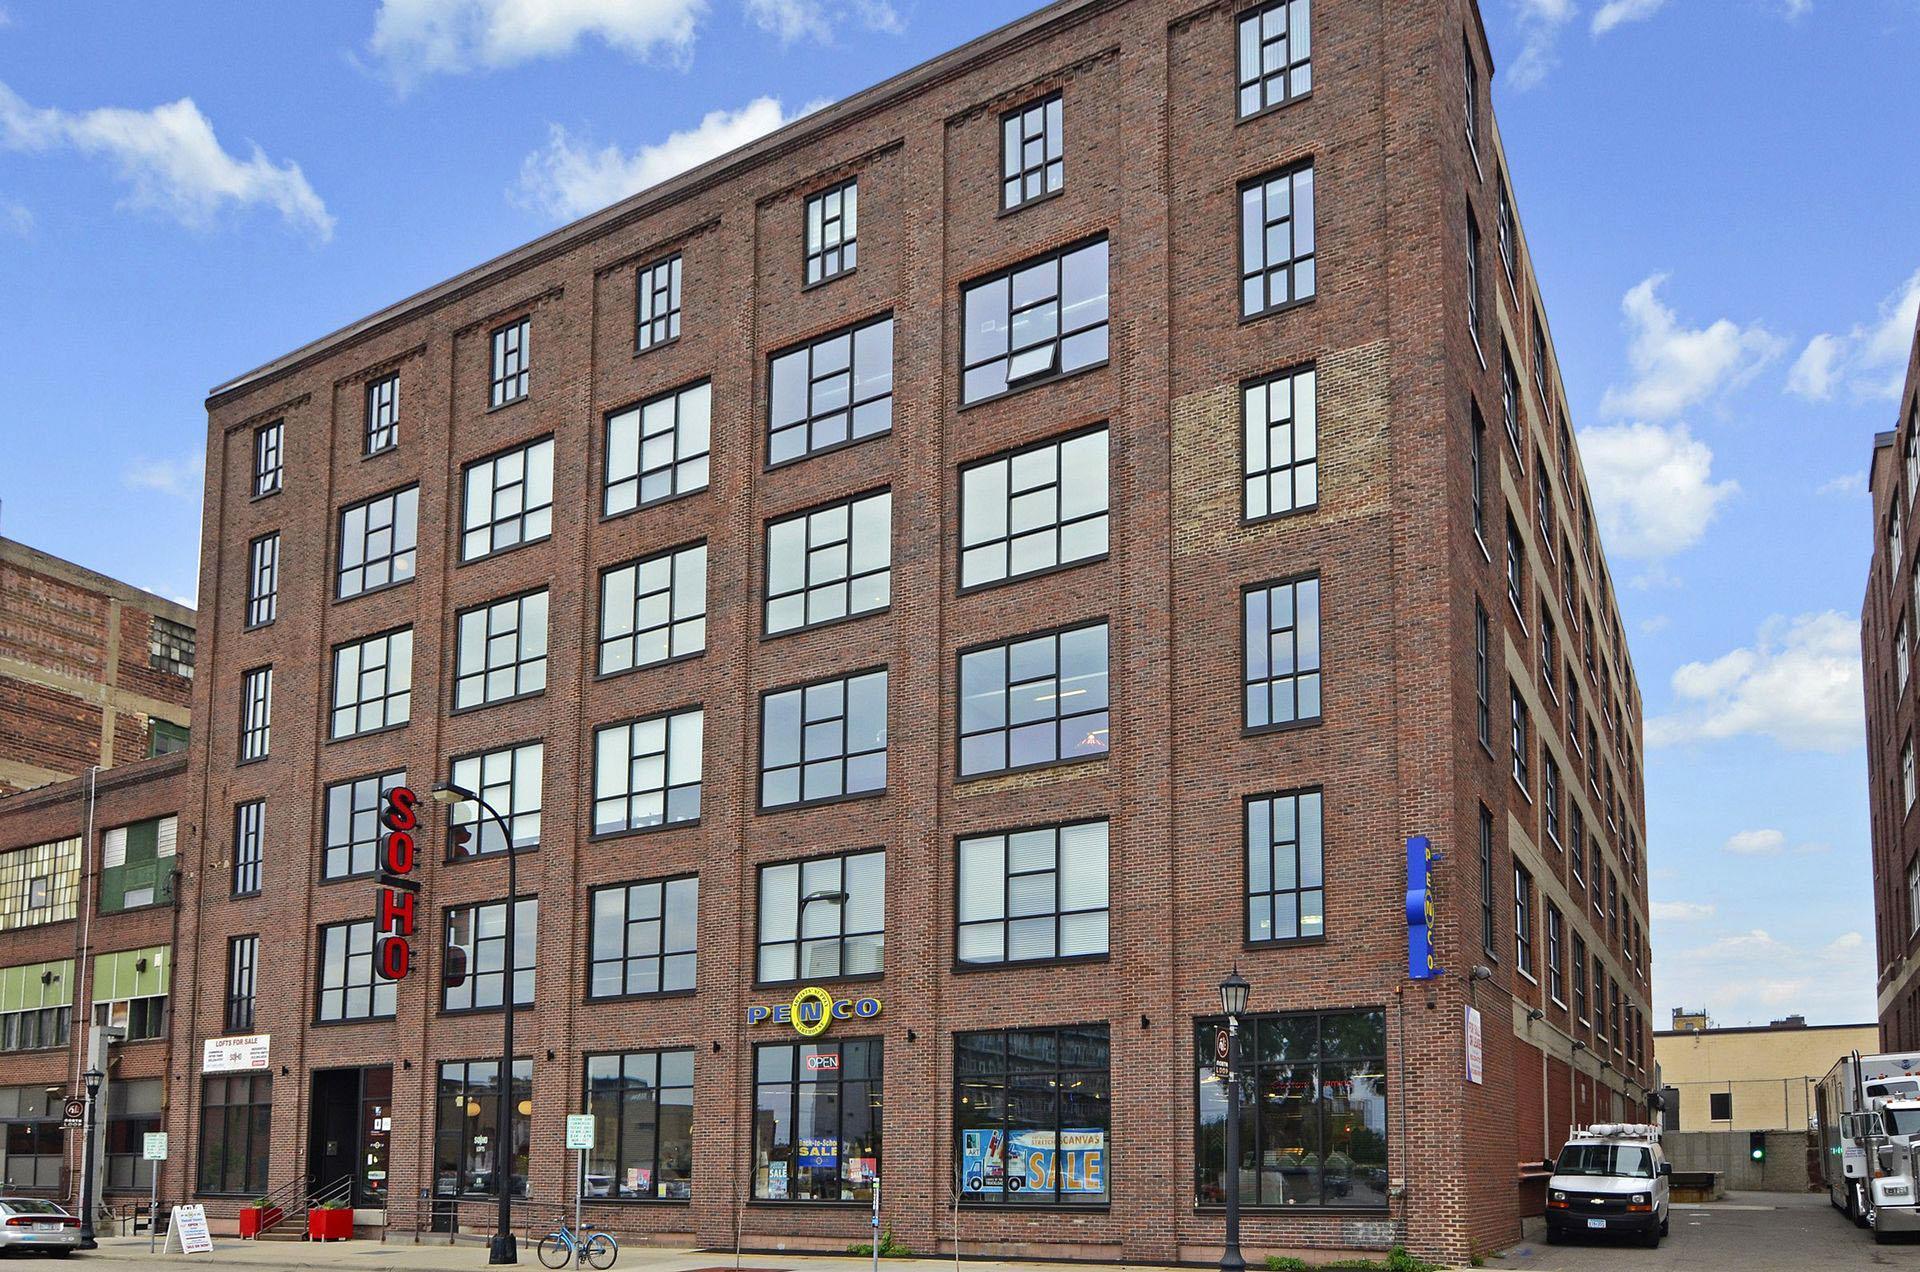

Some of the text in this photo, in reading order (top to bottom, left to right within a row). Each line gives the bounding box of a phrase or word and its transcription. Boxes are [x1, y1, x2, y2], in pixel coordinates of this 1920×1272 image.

[378, 786, 417, 981] SOHO
[1425, 847, 1434, 971] PENCO
[747, 996, 882, 1025] PENCO
[215, 1039, 232, 1048] LOFTS
[244, 1037, 258, 1045] SALE
[808, 1056, 837, 1068] OPEN
[1216, 1067, 1229, 1075] LOOP
[1063, 1135, 1100, 1145] CANVAS
[798, 1146, 838, 1157] SALE
[967, 1148, 980, 1156] ART
[769, 1168, 788, 1178] SALE
[1029, 1151, 1101, 1190] SALE
